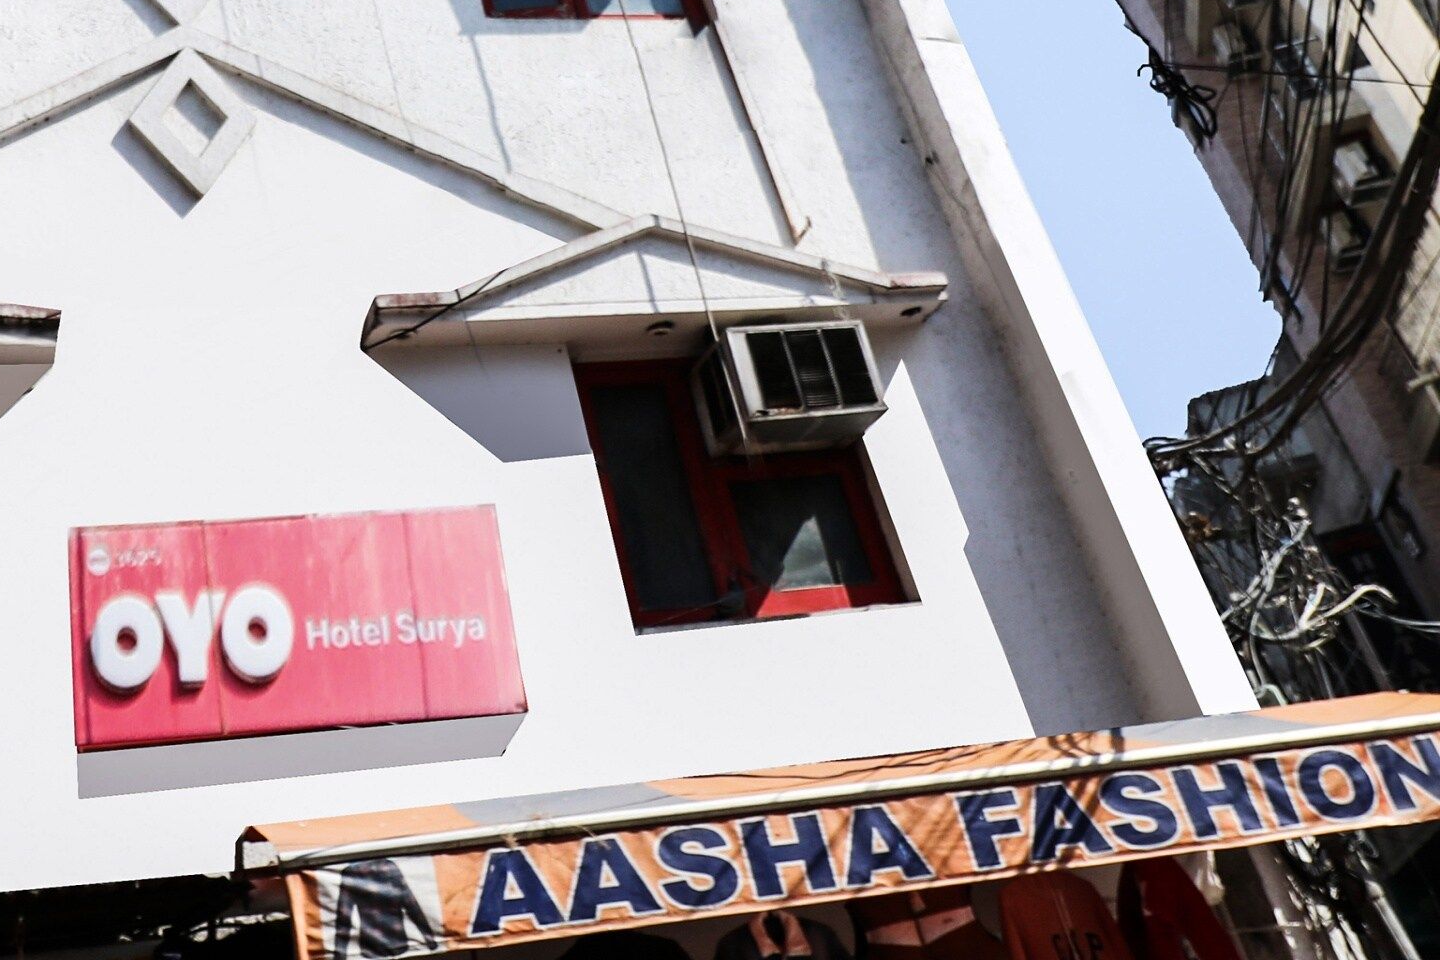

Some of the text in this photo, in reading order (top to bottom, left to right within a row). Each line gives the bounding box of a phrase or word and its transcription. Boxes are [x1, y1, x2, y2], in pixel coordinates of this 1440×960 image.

[90, 582, 295, 693] OYO
[305, 612, 487, 651] Hotel Surya
[467, 732, 1440, 938] AASHA FASHION
